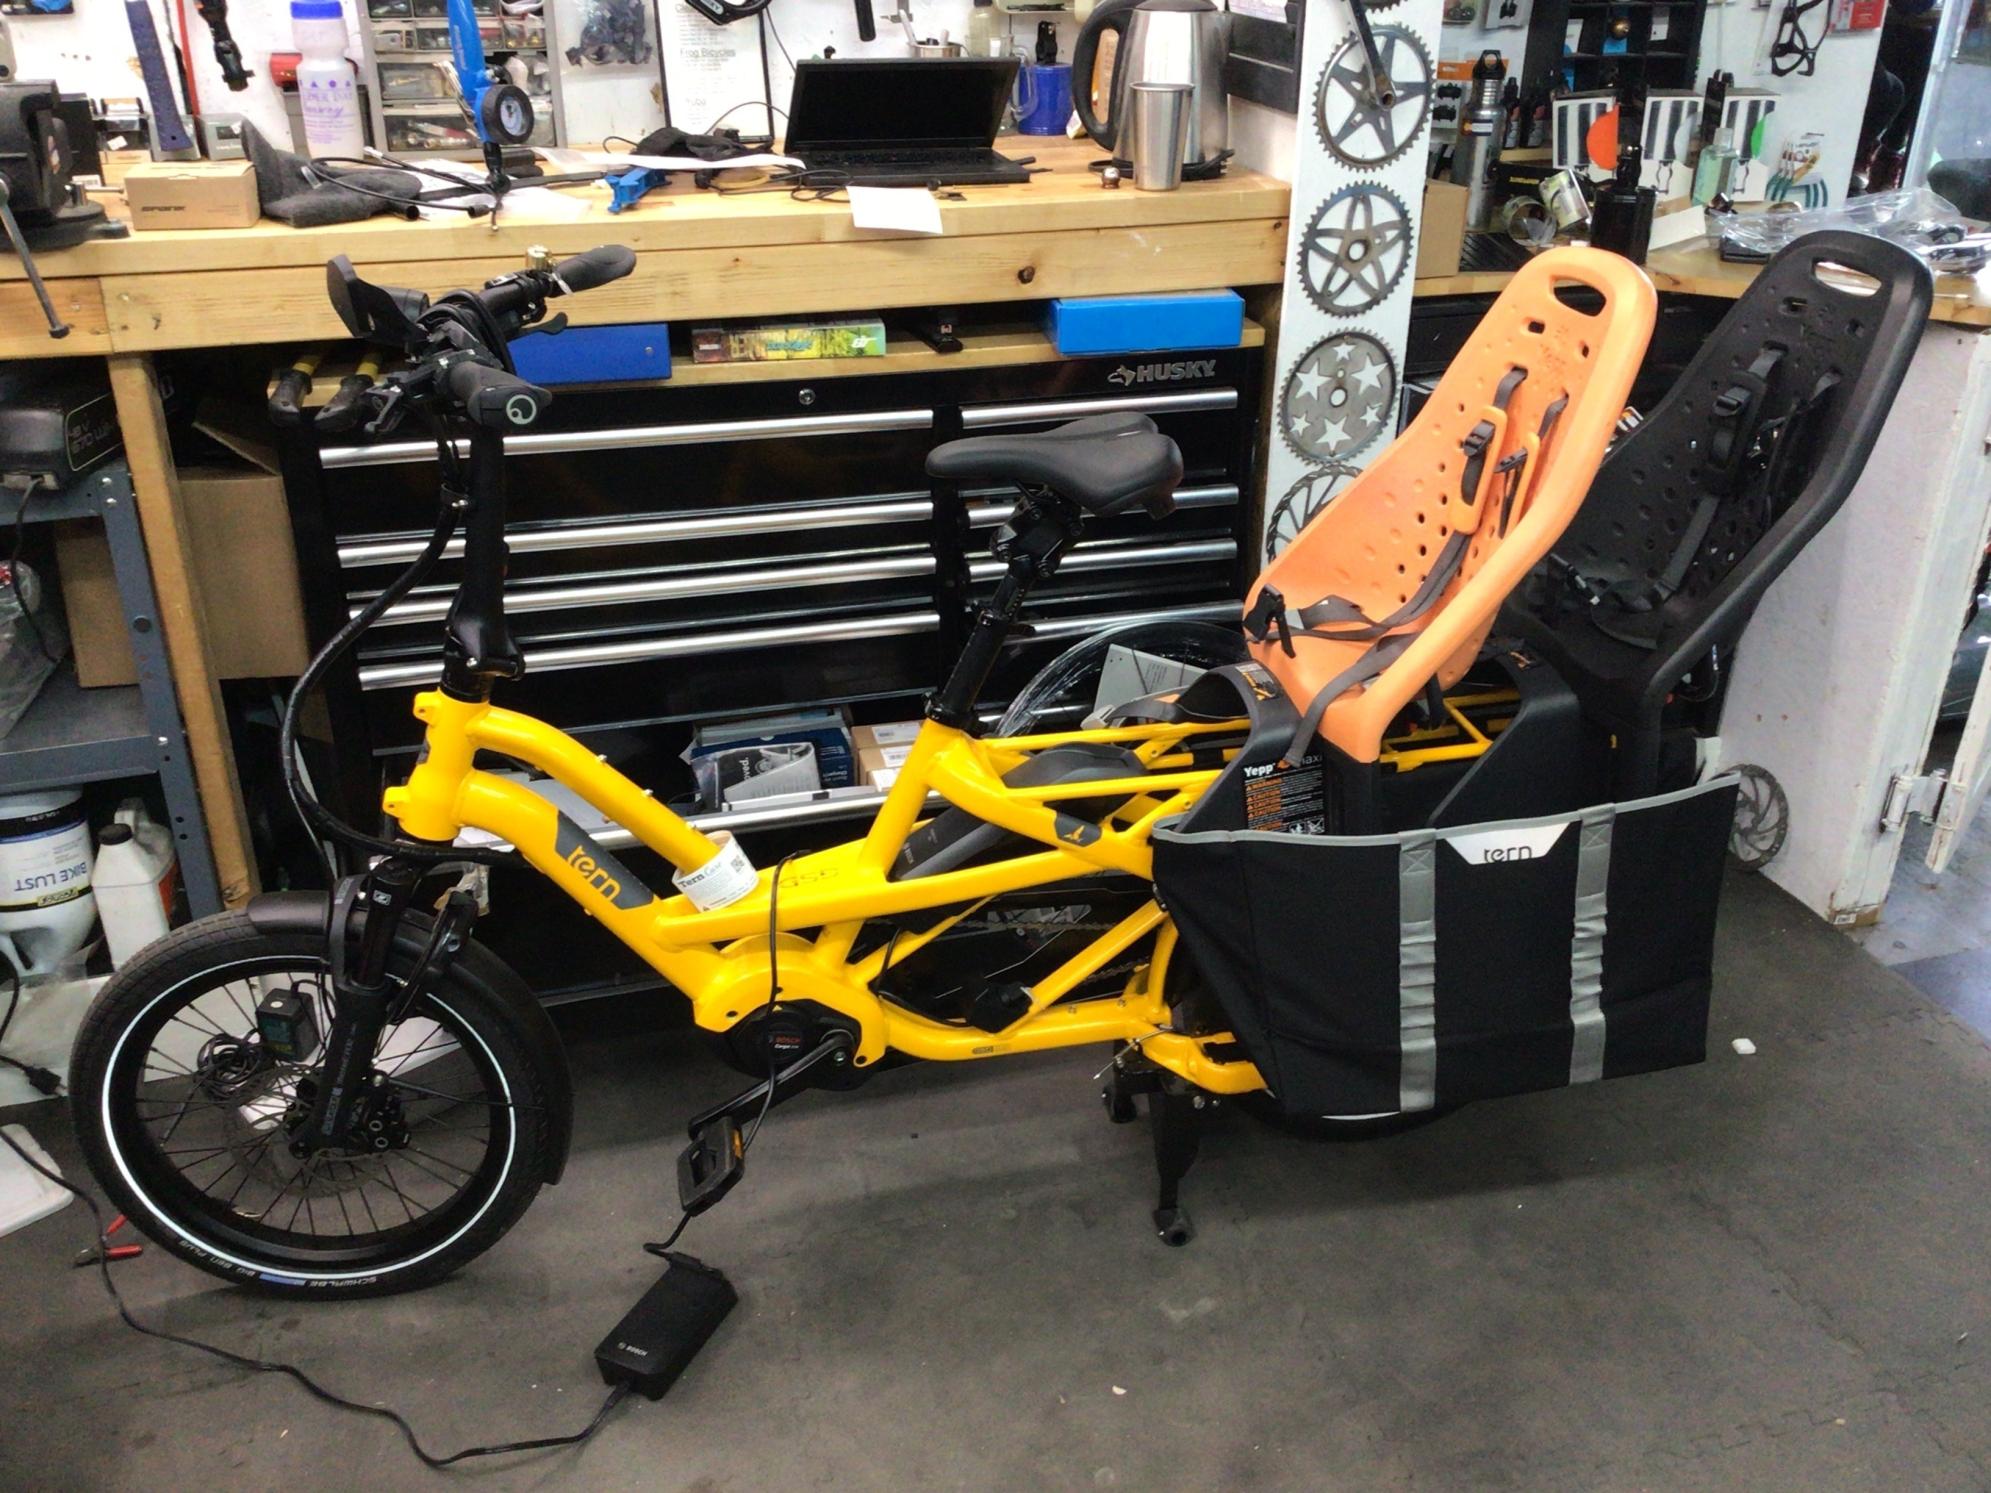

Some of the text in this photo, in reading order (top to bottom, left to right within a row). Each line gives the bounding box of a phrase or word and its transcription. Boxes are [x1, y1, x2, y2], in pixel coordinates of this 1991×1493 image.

[1136, 359, 1216, 383] HUSKY
[1243, 763, 1276, 778] Yepp
[1483, 845, 1533, 863] tern
[14, 861, 87, 892] BIKE LUST
[567, 845, 621, 902] tern
